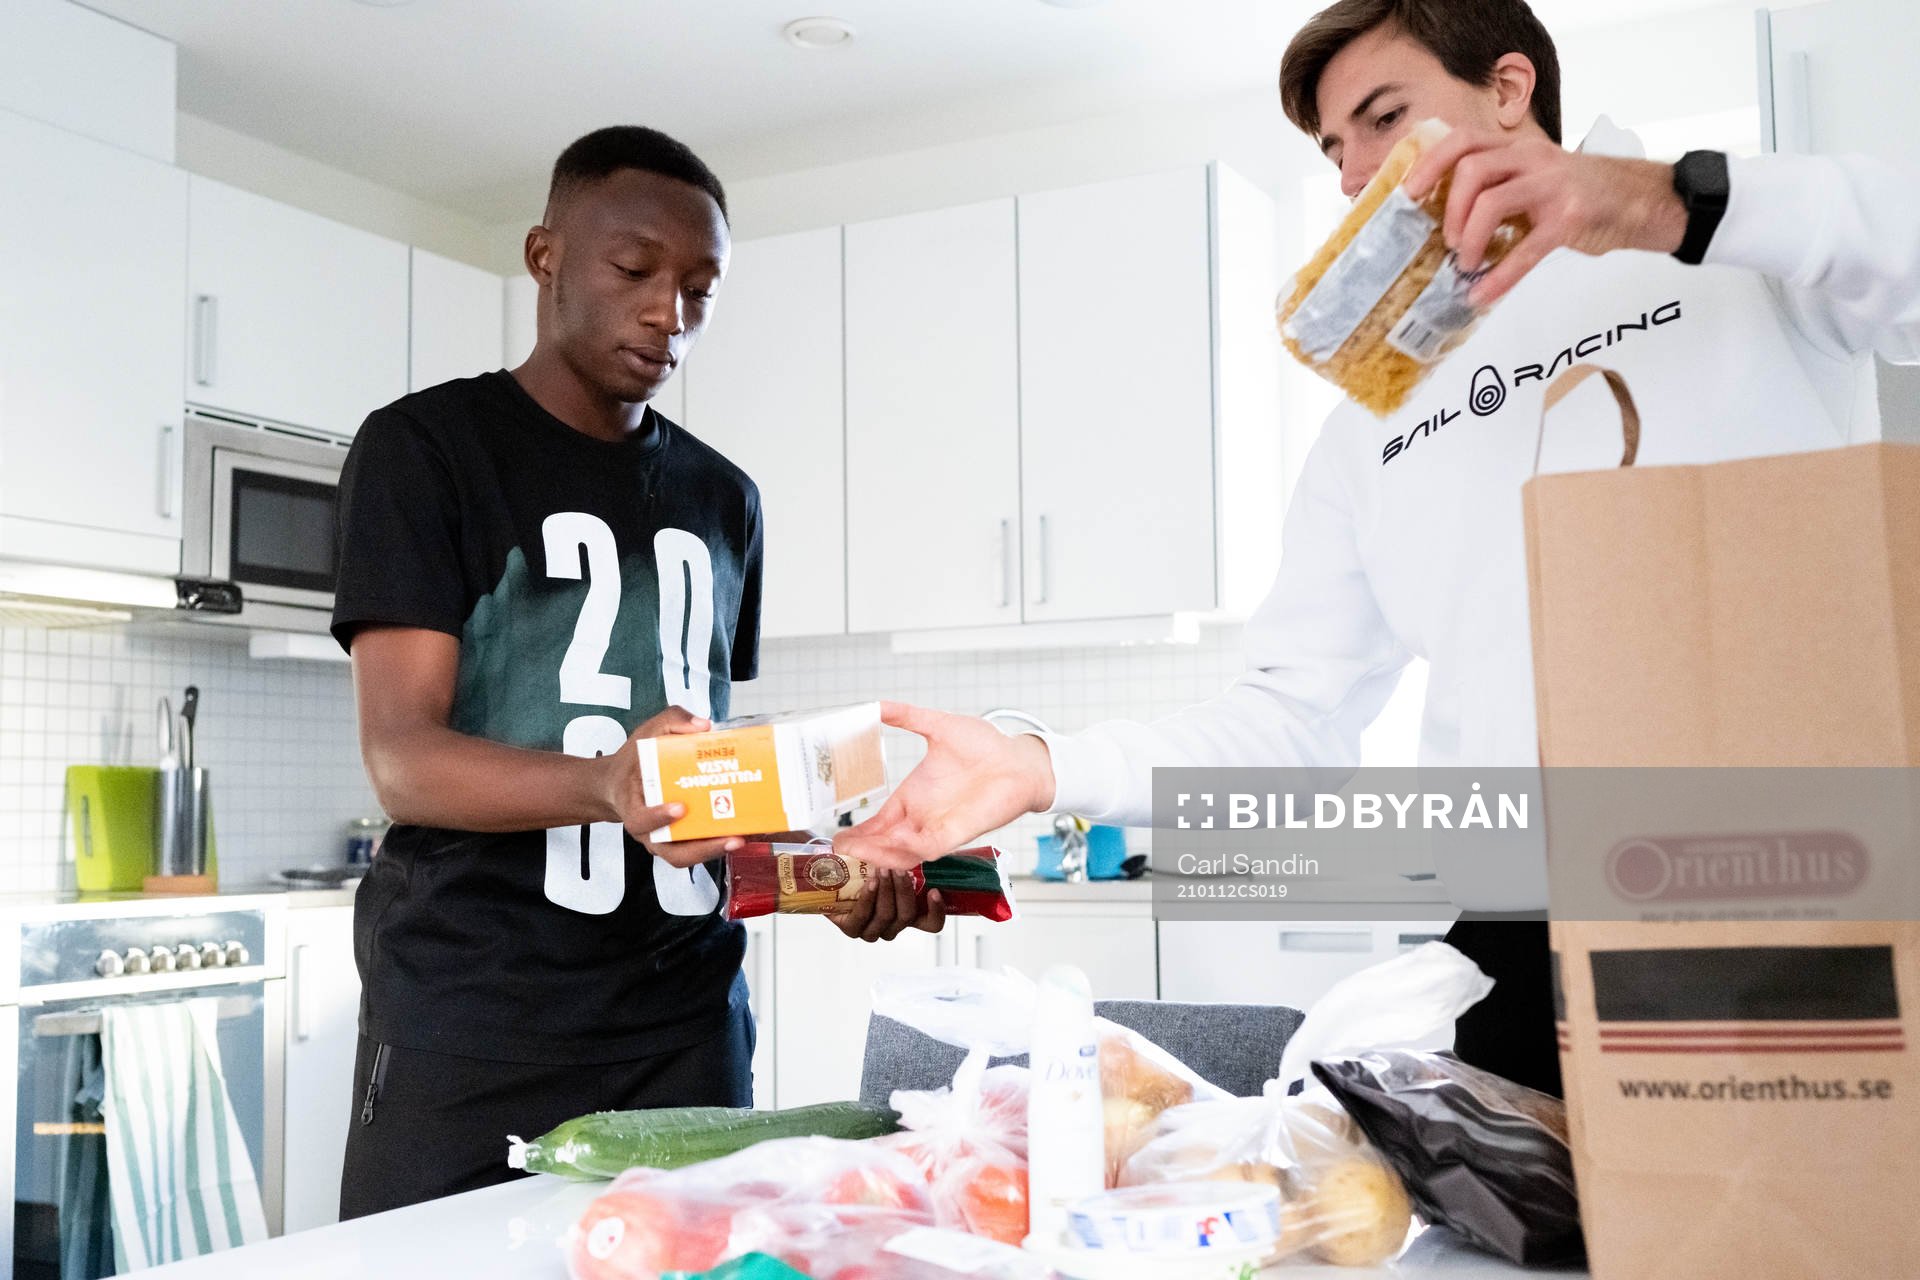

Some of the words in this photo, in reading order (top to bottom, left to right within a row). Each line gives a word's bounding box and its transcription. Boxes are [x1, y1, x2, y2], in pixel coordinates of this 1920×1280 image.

[1382, 408, 1461, 466] SAIL
[1514, 301, 1681, 387] RACING
[542, 511, 714, 720] 20
[696, 747, 736, 759] PENNE
[697, 759, 740, 774] PASTA
[1612, 838, 1857, 900] Orienthus
[1618, 1076, 1893, 1100] www.orienthus.se
